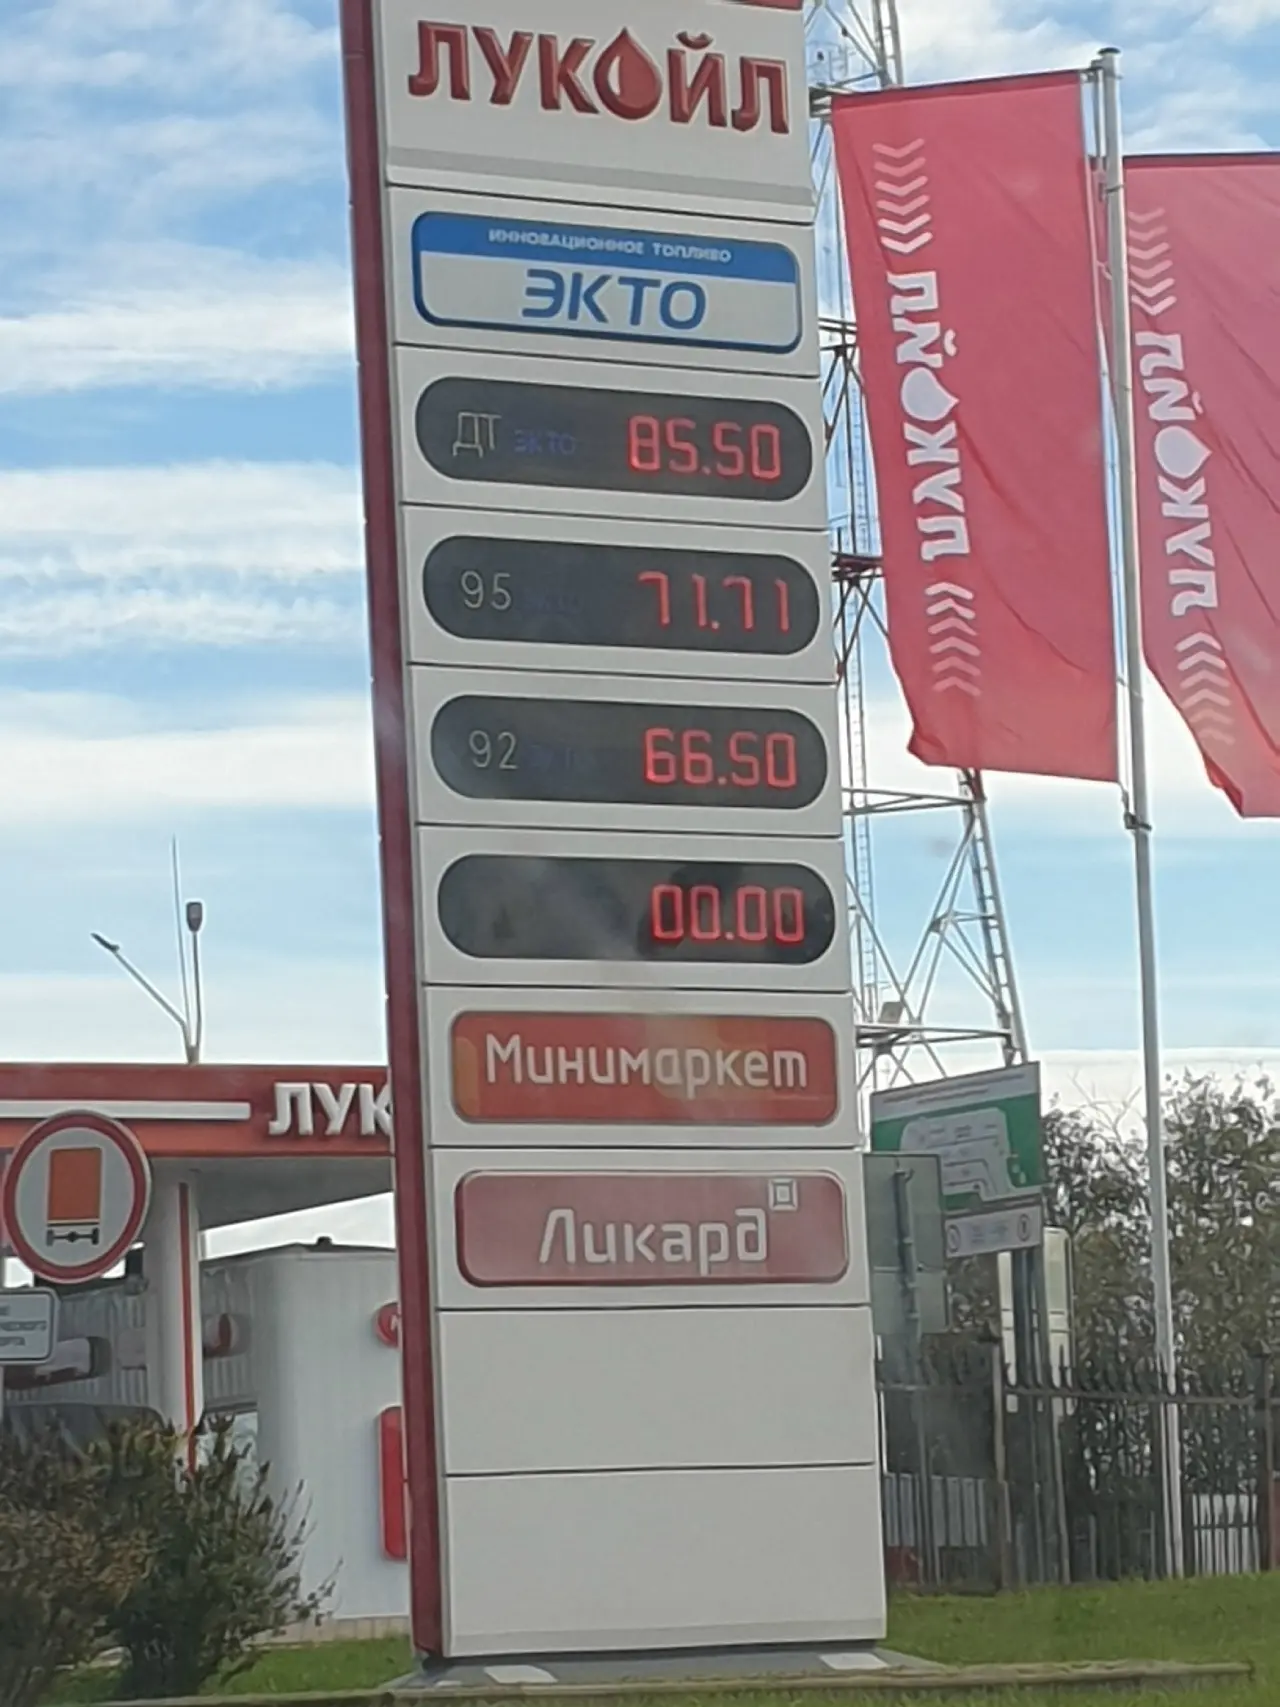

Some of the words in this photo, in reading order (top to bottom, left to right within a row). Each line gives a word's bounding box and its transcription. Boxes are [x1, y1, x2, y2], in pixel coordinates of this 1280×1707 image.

[408, 20, 790, 134] ЛУКОЙЛ
[488, 228, 645, 255] ИННОВАЦИОННОЕ
[653, 242, 733, 263] ТОПЛИВО
[521, 268, 707, 330] ЭКТО
[452, 411, 502, 459] ДТ
[628, 415, 783, 480] 85.50
[460, 570, 512, 611] 95
[638, 570, 791, 633] 71.71
[468, 729, 519, 770] 92
[643, 727, 798, 788] 66.50
[651, 883, 805, 943] 00.00
[485, 1033, 807, 1099] Минимаркет
[539, 1208, 768, 1276] Ликард
